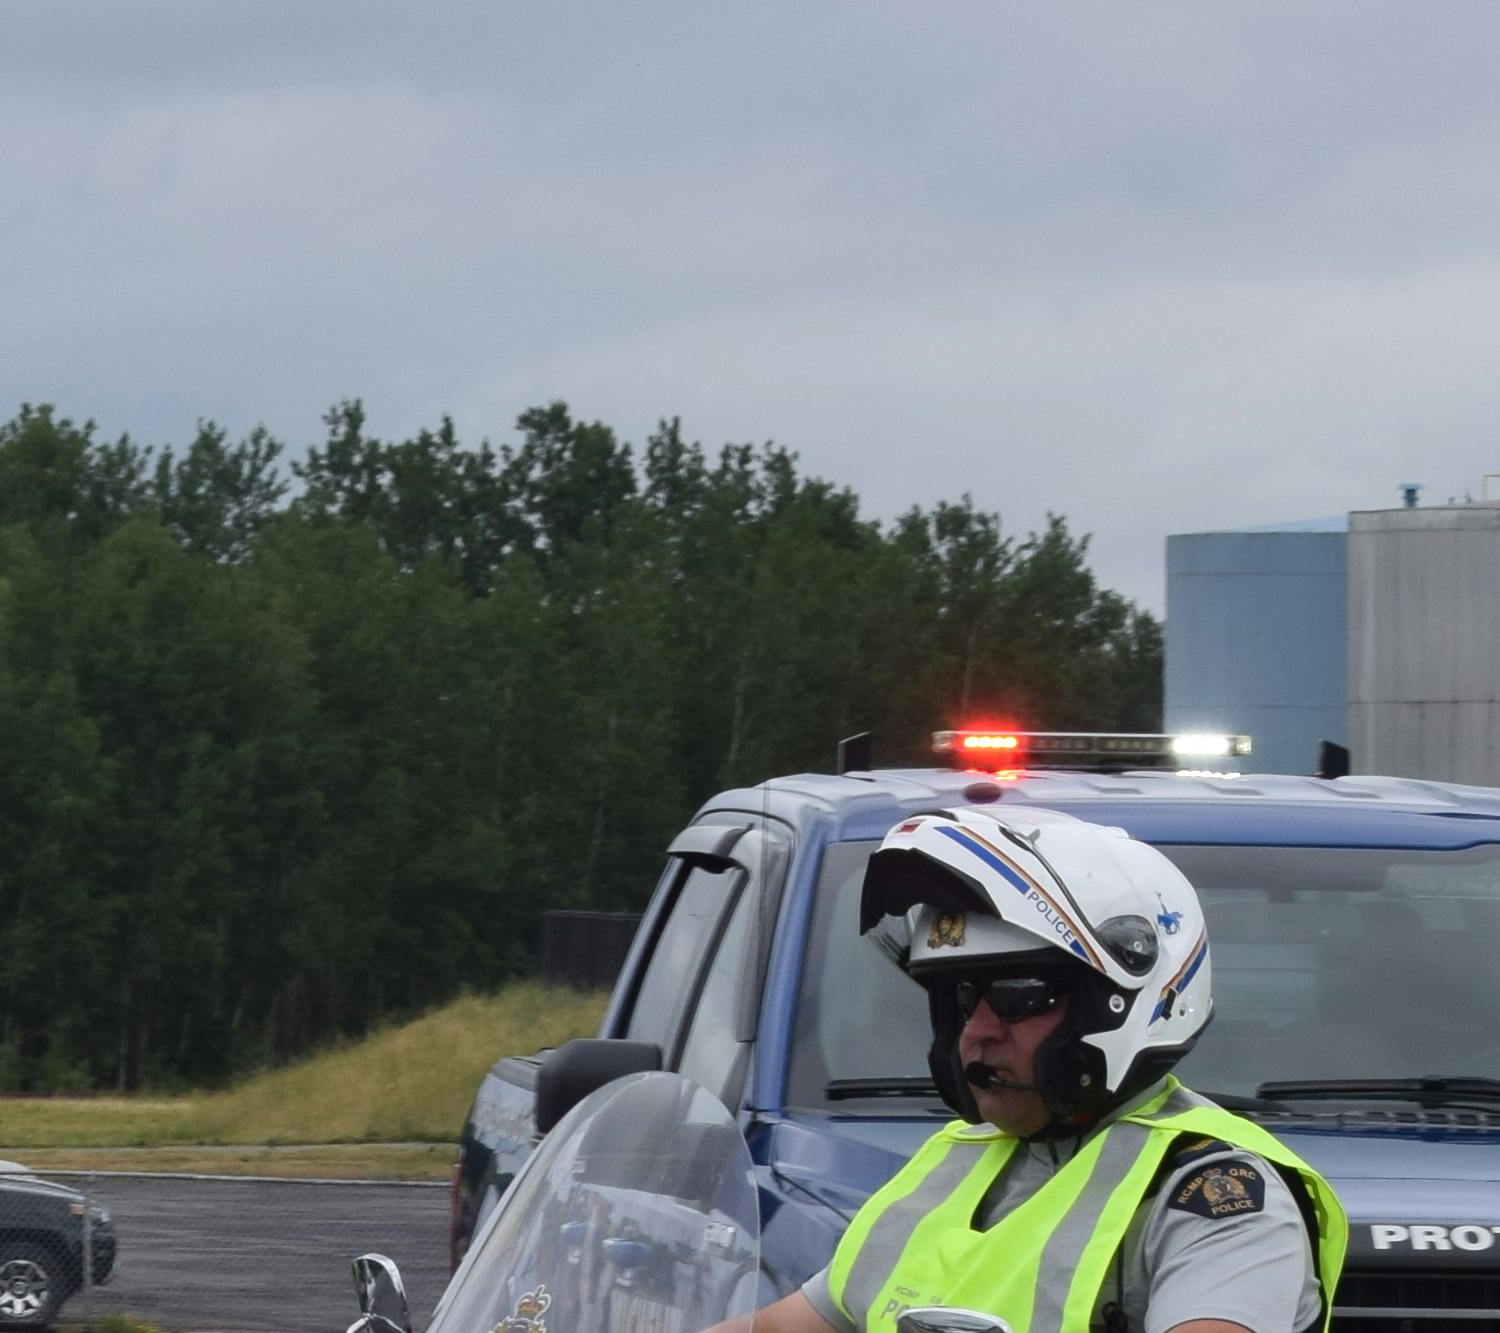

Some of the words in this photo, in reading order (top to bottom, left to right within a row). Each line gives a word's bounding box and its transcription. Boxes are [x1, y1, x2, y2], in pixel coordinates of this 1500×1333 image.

[1027, 890, 1076, 944] POLICE
[1177, 1176, 1204, 1204] RCMP
[1228, 1168, 1257, 1180] GRC
[1211, 1199, 1255, 1216] POLICE
